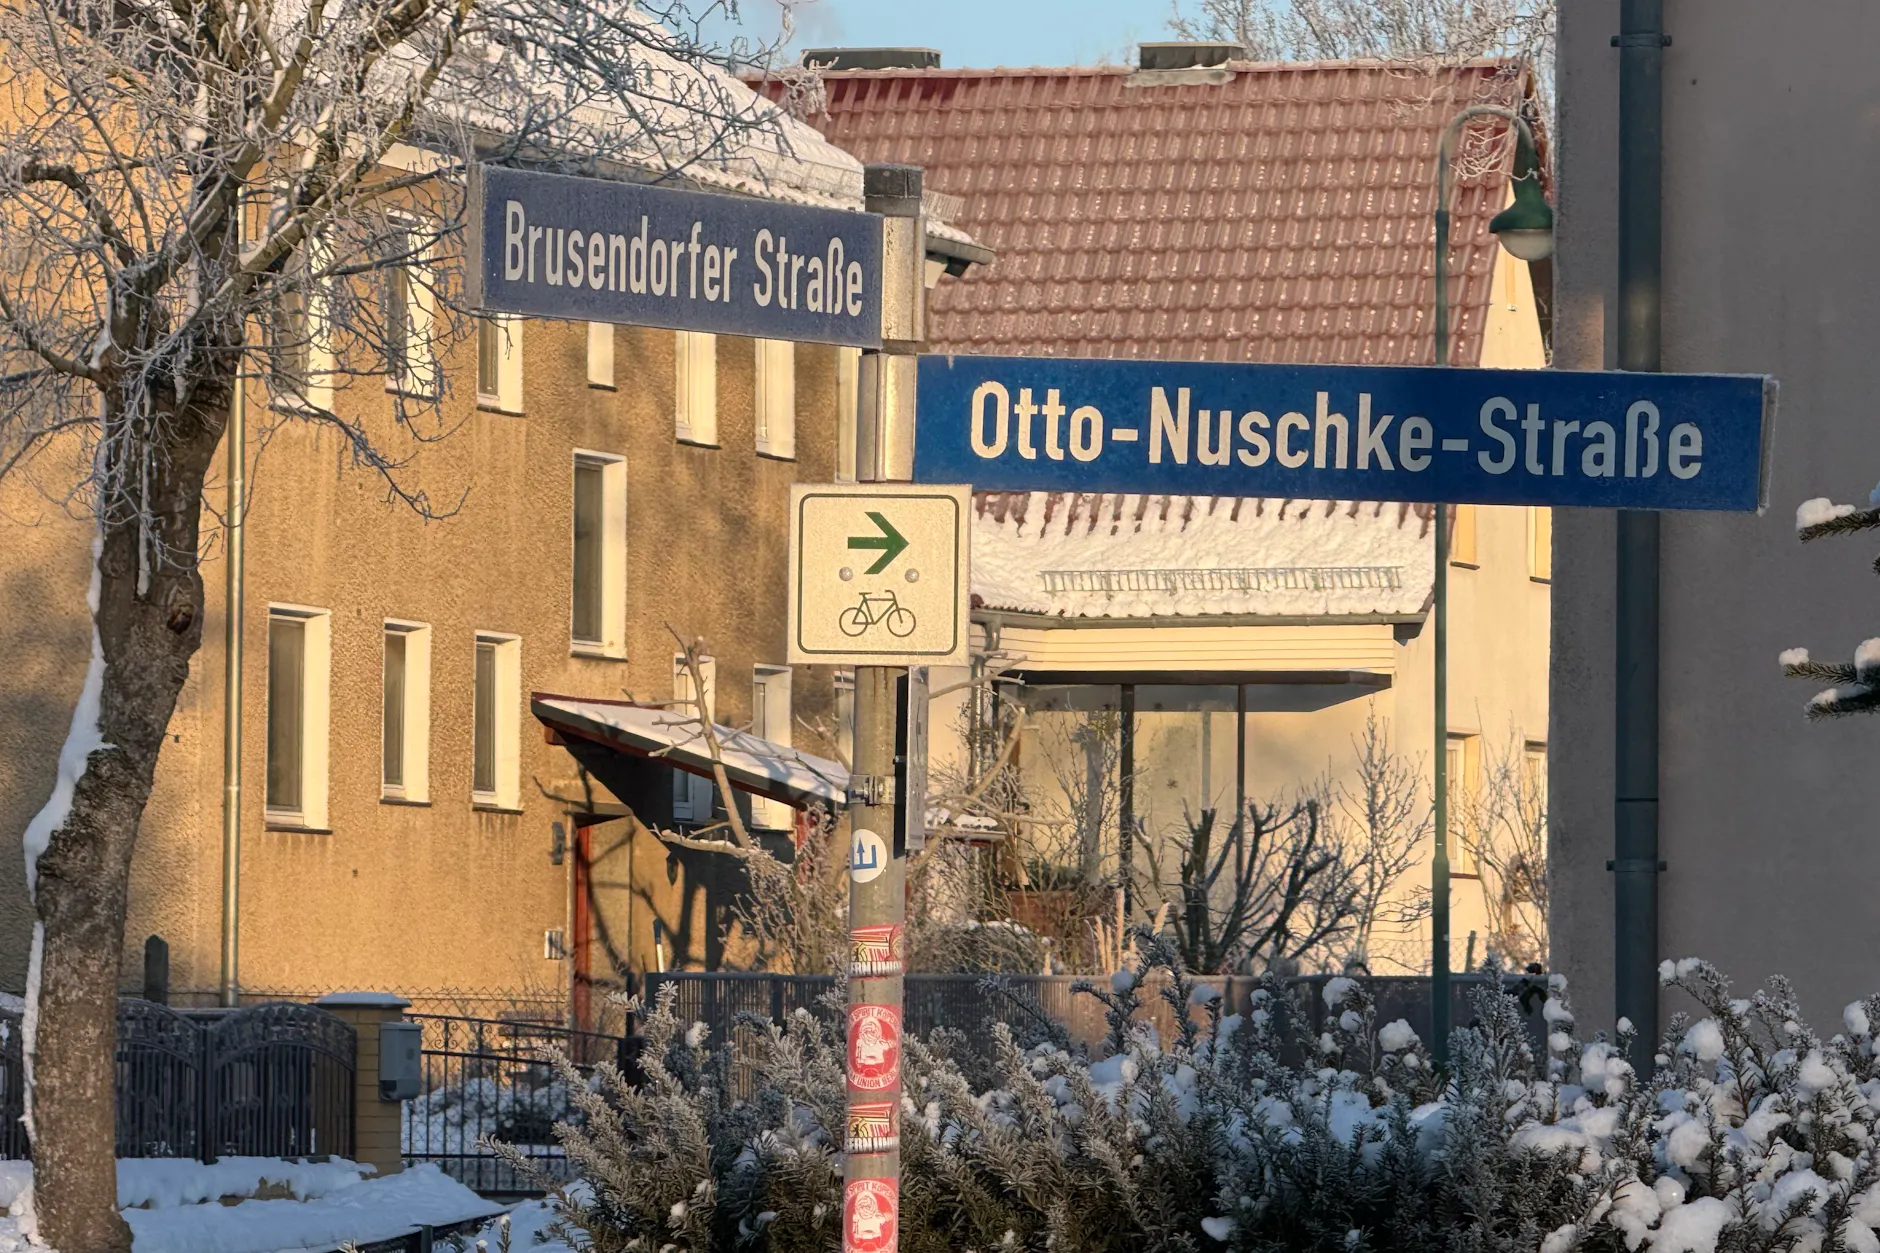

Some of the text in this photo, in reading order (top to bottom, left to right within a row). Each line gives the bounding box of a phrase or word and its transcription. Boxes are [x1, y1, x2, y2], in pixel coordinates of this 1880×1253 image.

[504, 200, 864, 318] Brusendorfer Straße
[970, 380, 1703, 480] Otto-Nuschke-Straße
